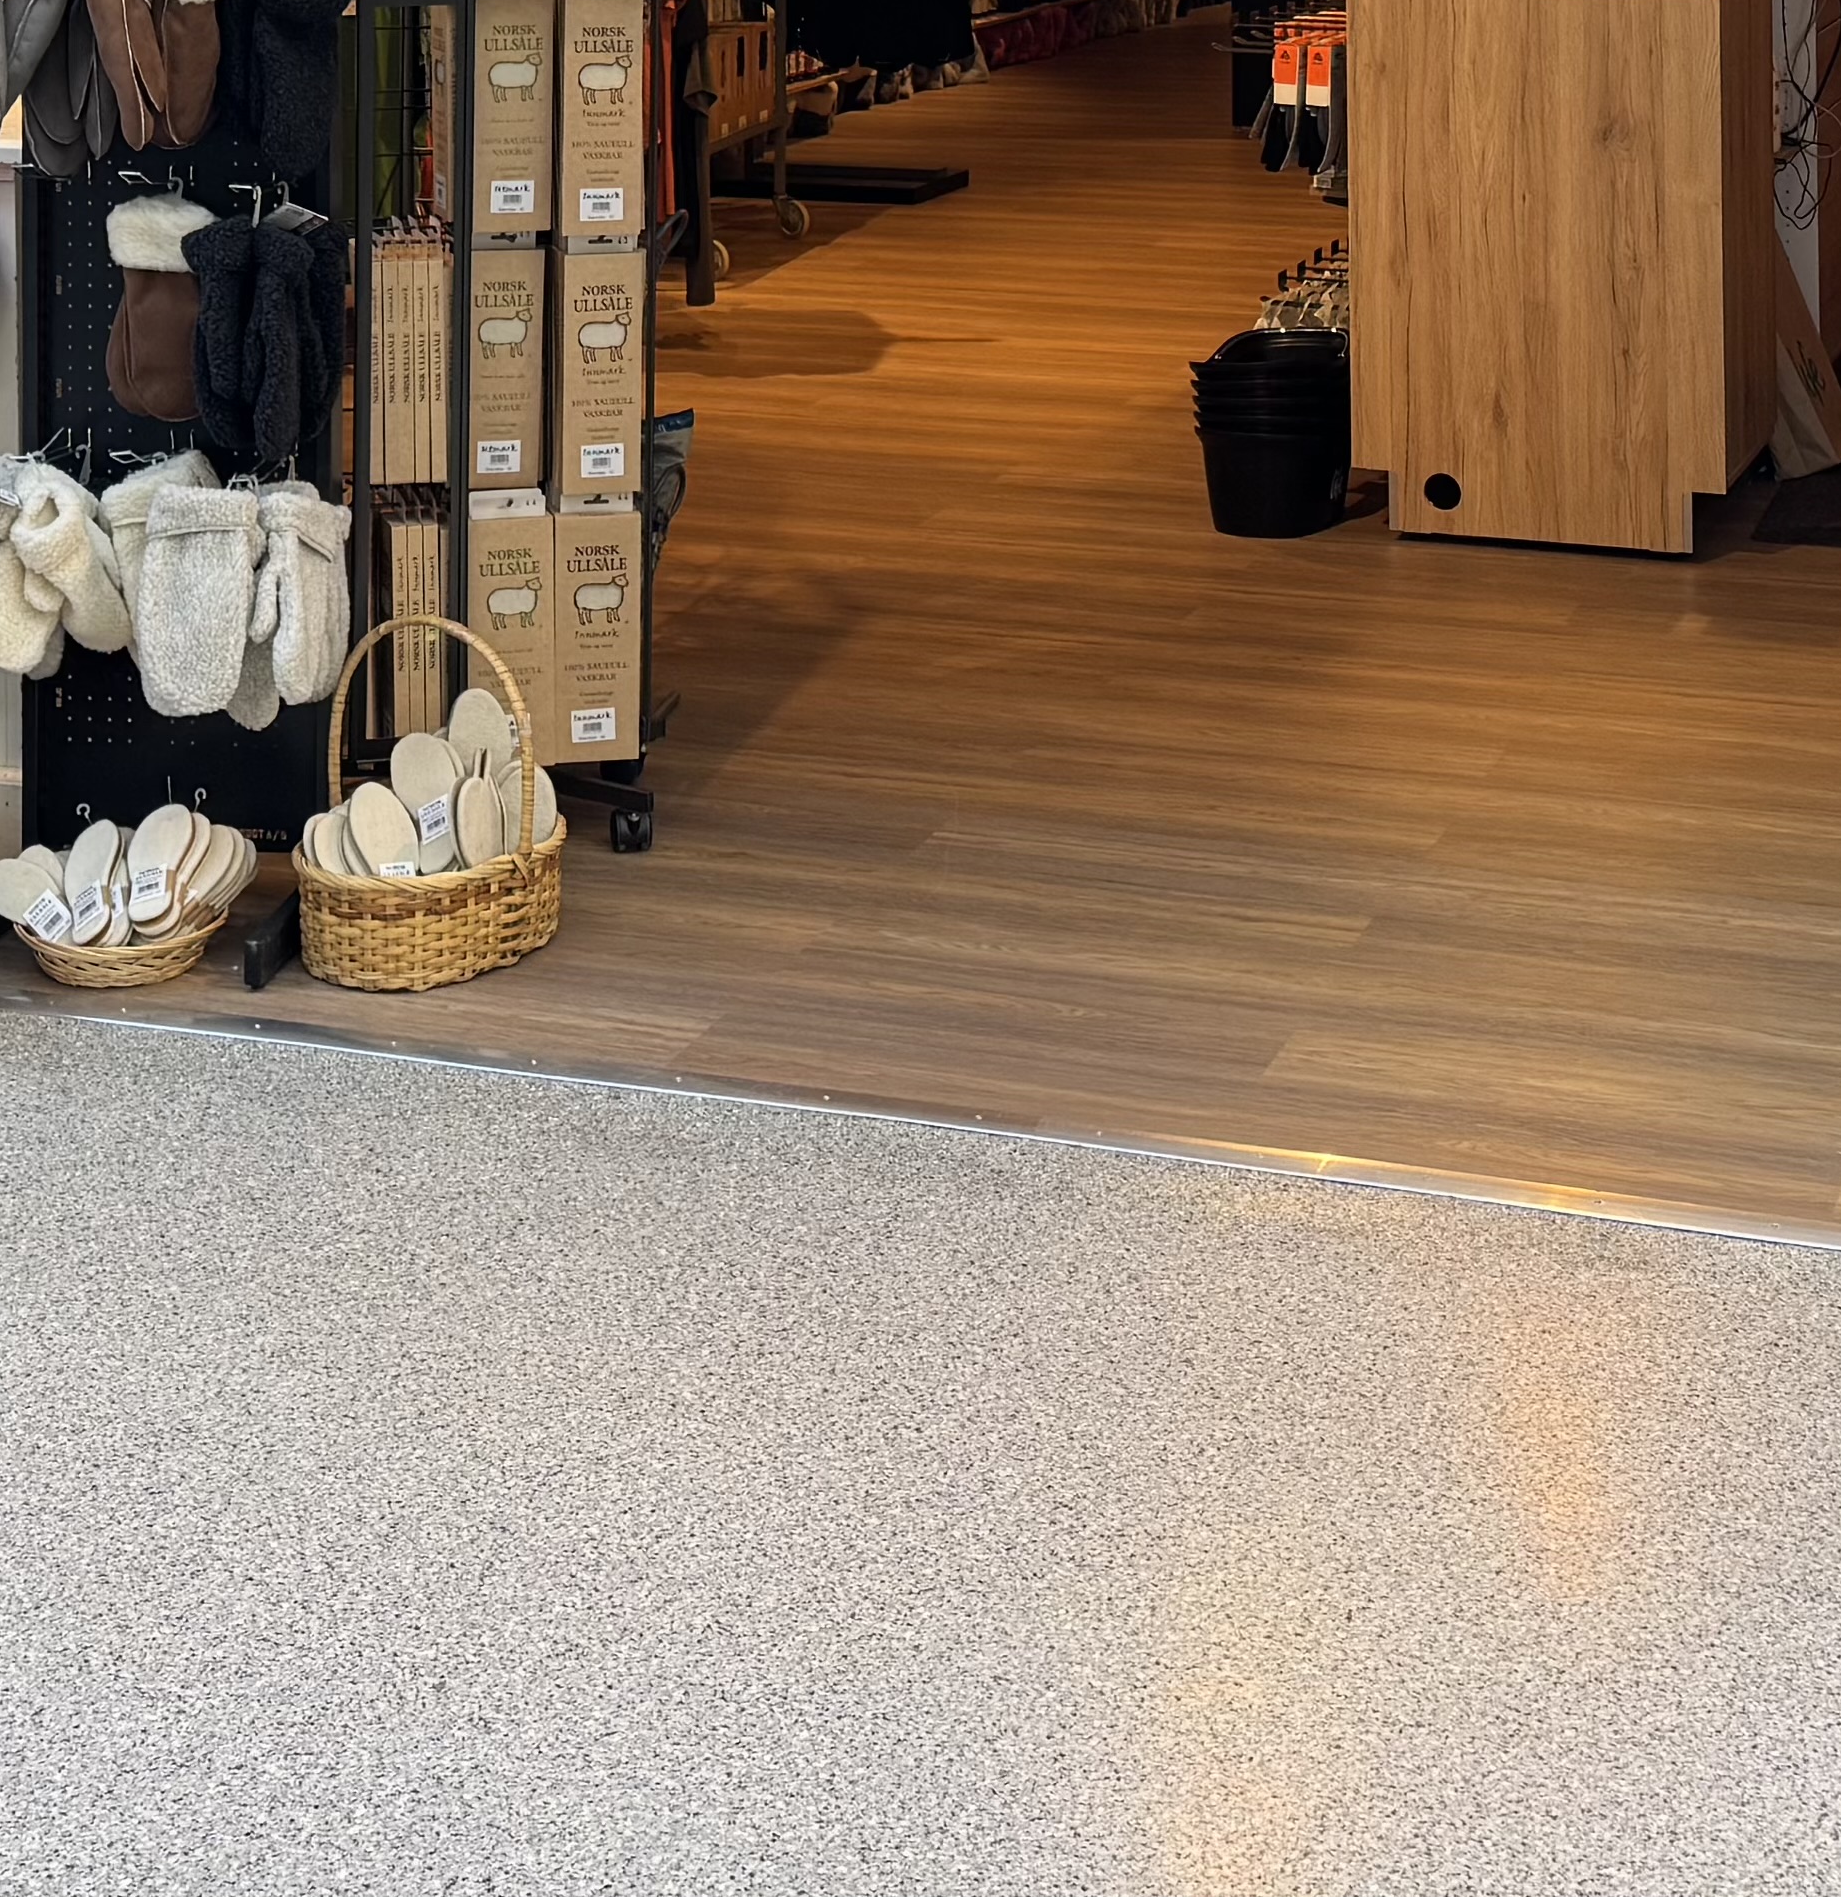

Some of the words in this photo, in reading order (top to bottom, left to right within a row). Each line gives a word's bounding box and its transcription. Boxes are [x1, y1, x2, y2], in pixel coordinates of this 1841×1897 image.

[492, 24, 536, 36] NORSK
[582, 26, 626, 38] NORSK
[484, 37, 544, 52] ULLSÅLE
[574, 39, 634, 54] ULLSÅLE
[482, 280, 527, 292] NORSK
[581, 284, 626, 296] NORSK
[474, 293, 535, 309] ULLSÅLE
[573, 297, 634, 313] ULLSÅLE
[487, 548, 533, 560] NORSK
[574, 545, 620, 557] NORSK
[479, 561, 540, 577] ULLSÅLE
[566, 557, 628, 573] ULLSÅLE
